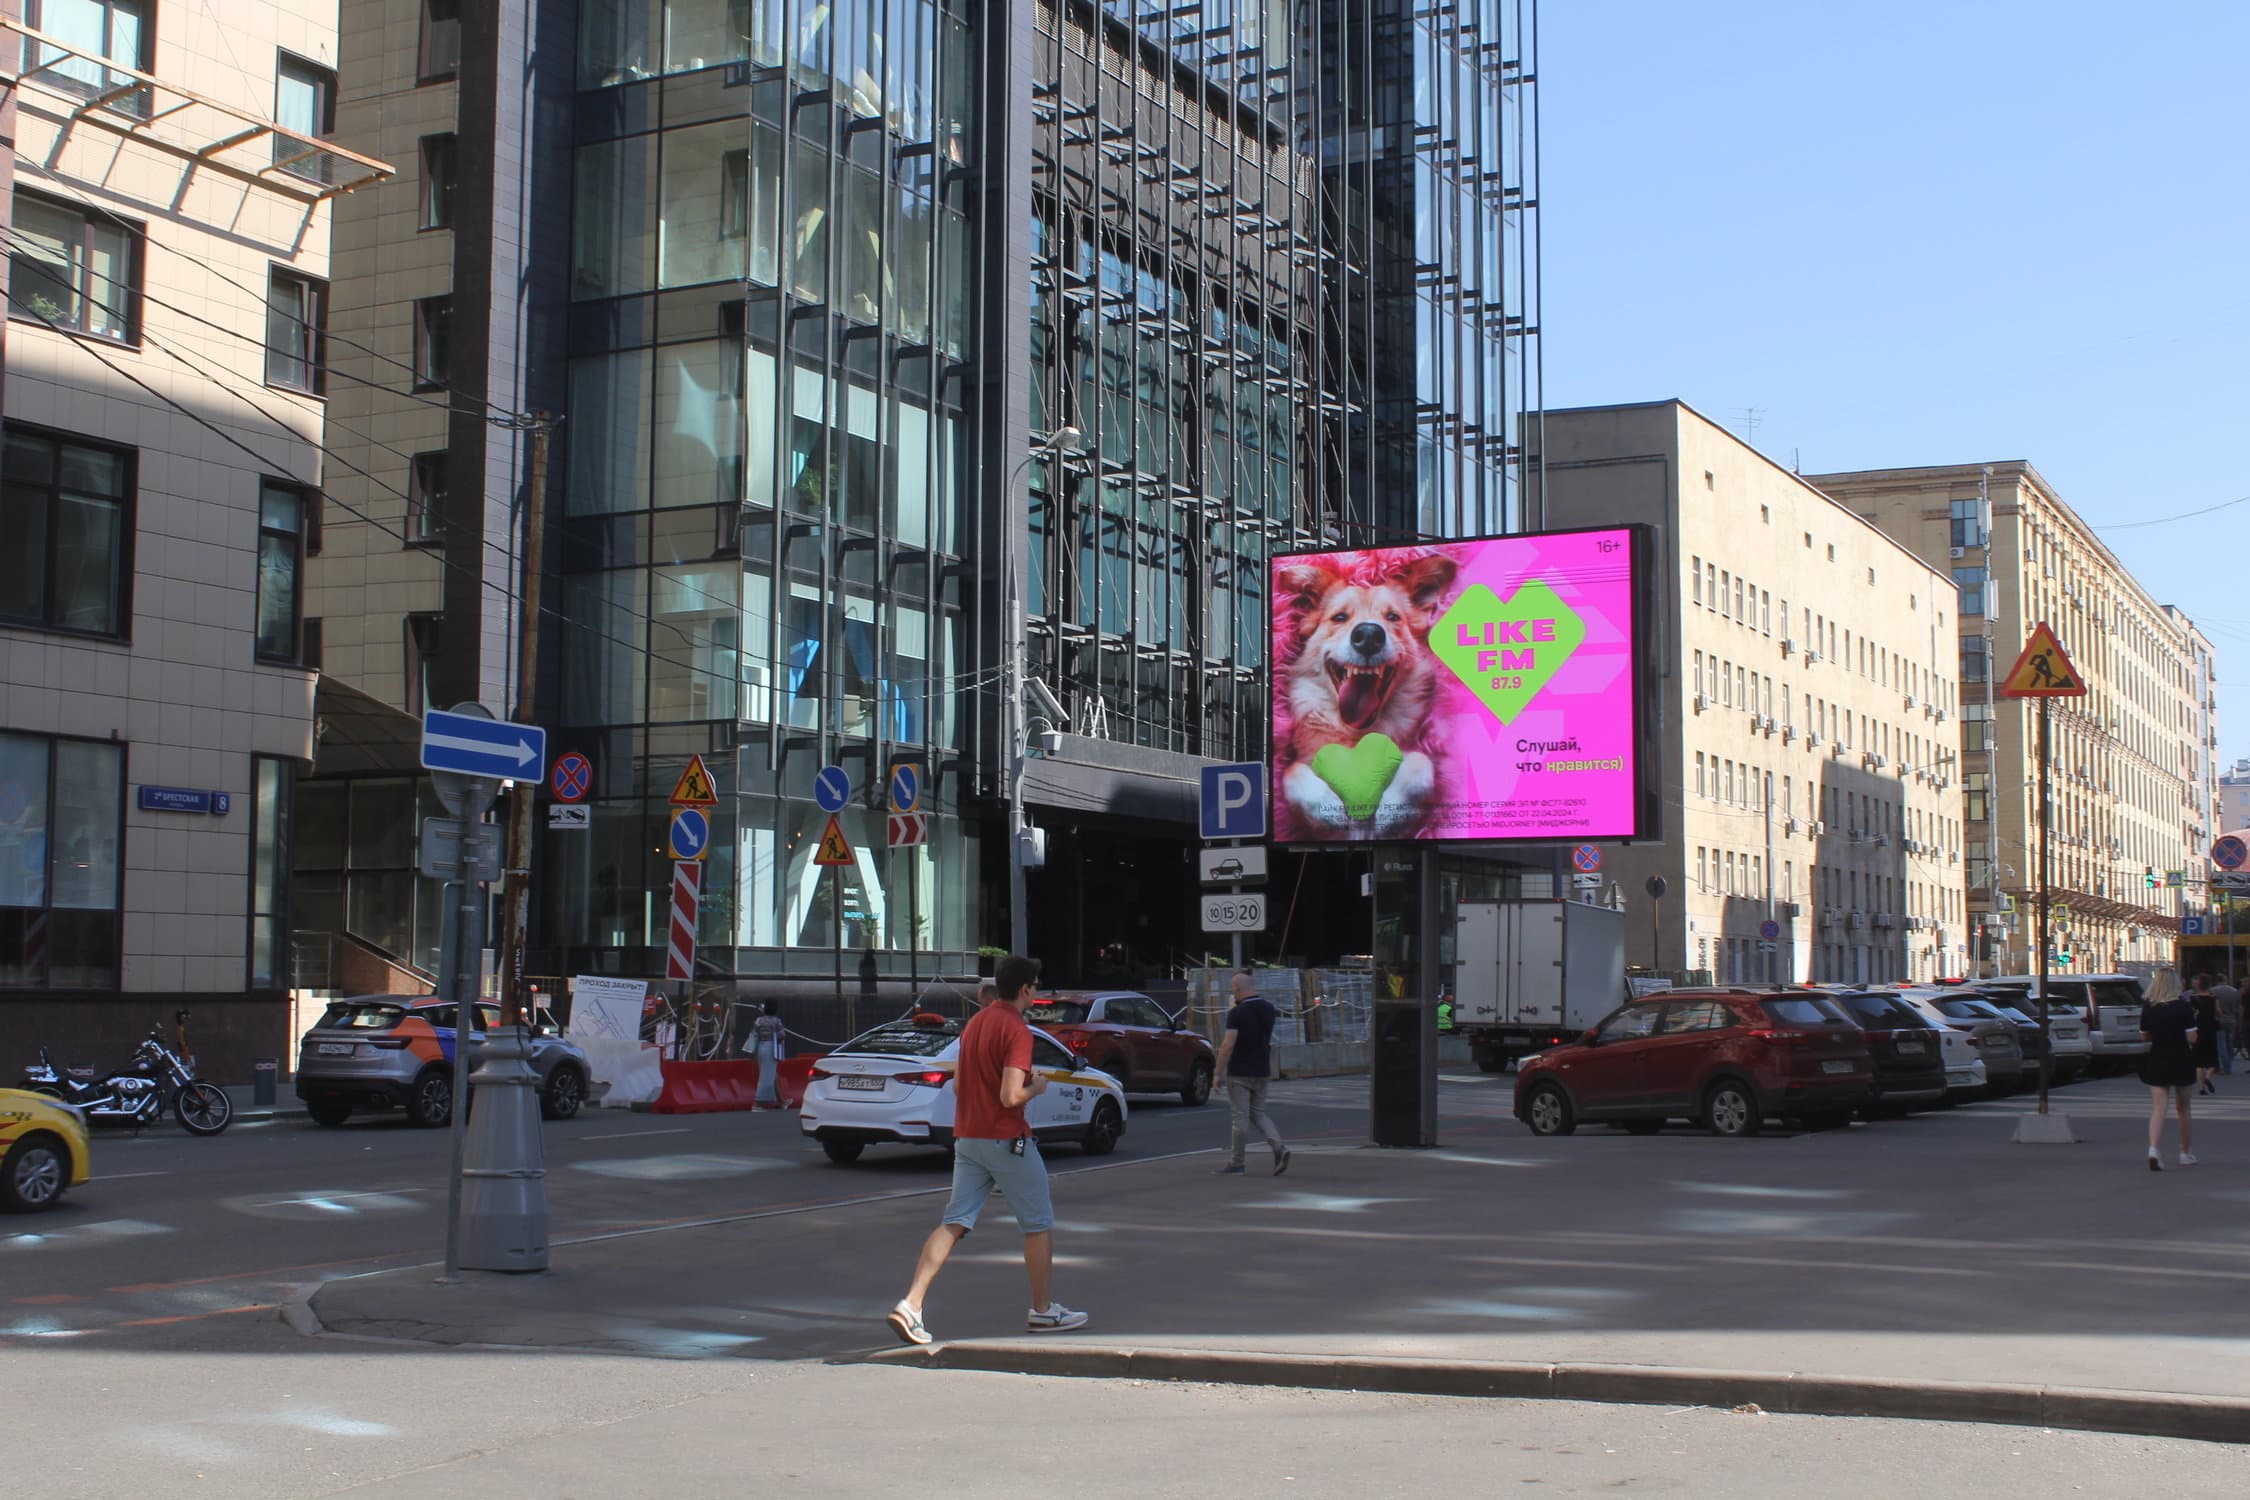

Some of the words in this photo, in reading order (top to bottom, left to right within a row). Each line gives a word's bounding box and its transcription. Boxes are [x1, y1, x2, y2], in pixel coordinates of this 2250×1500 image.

[1597, 540, 1621, 553] 16+
[1457, 619, 1556, 647] LIKE
[1477, 648, 1535, 672] FM
[1491, 676, 1522, 690] 87.9
[1516, 737, 1581, 755] Слушай,
[1516, 761, 1542, 773] что
[1546, 755, 1624, 774] нравится)
[219, 796, 227, 810] 8
[1217, 772, 1252, 829] P
[1209, 908, 1219, 919] 10
[1223, 906, 1234, 919] 15
[1239, 904, 1258, 920] 20
[579, 978, 611, 988] ПРОХОД
